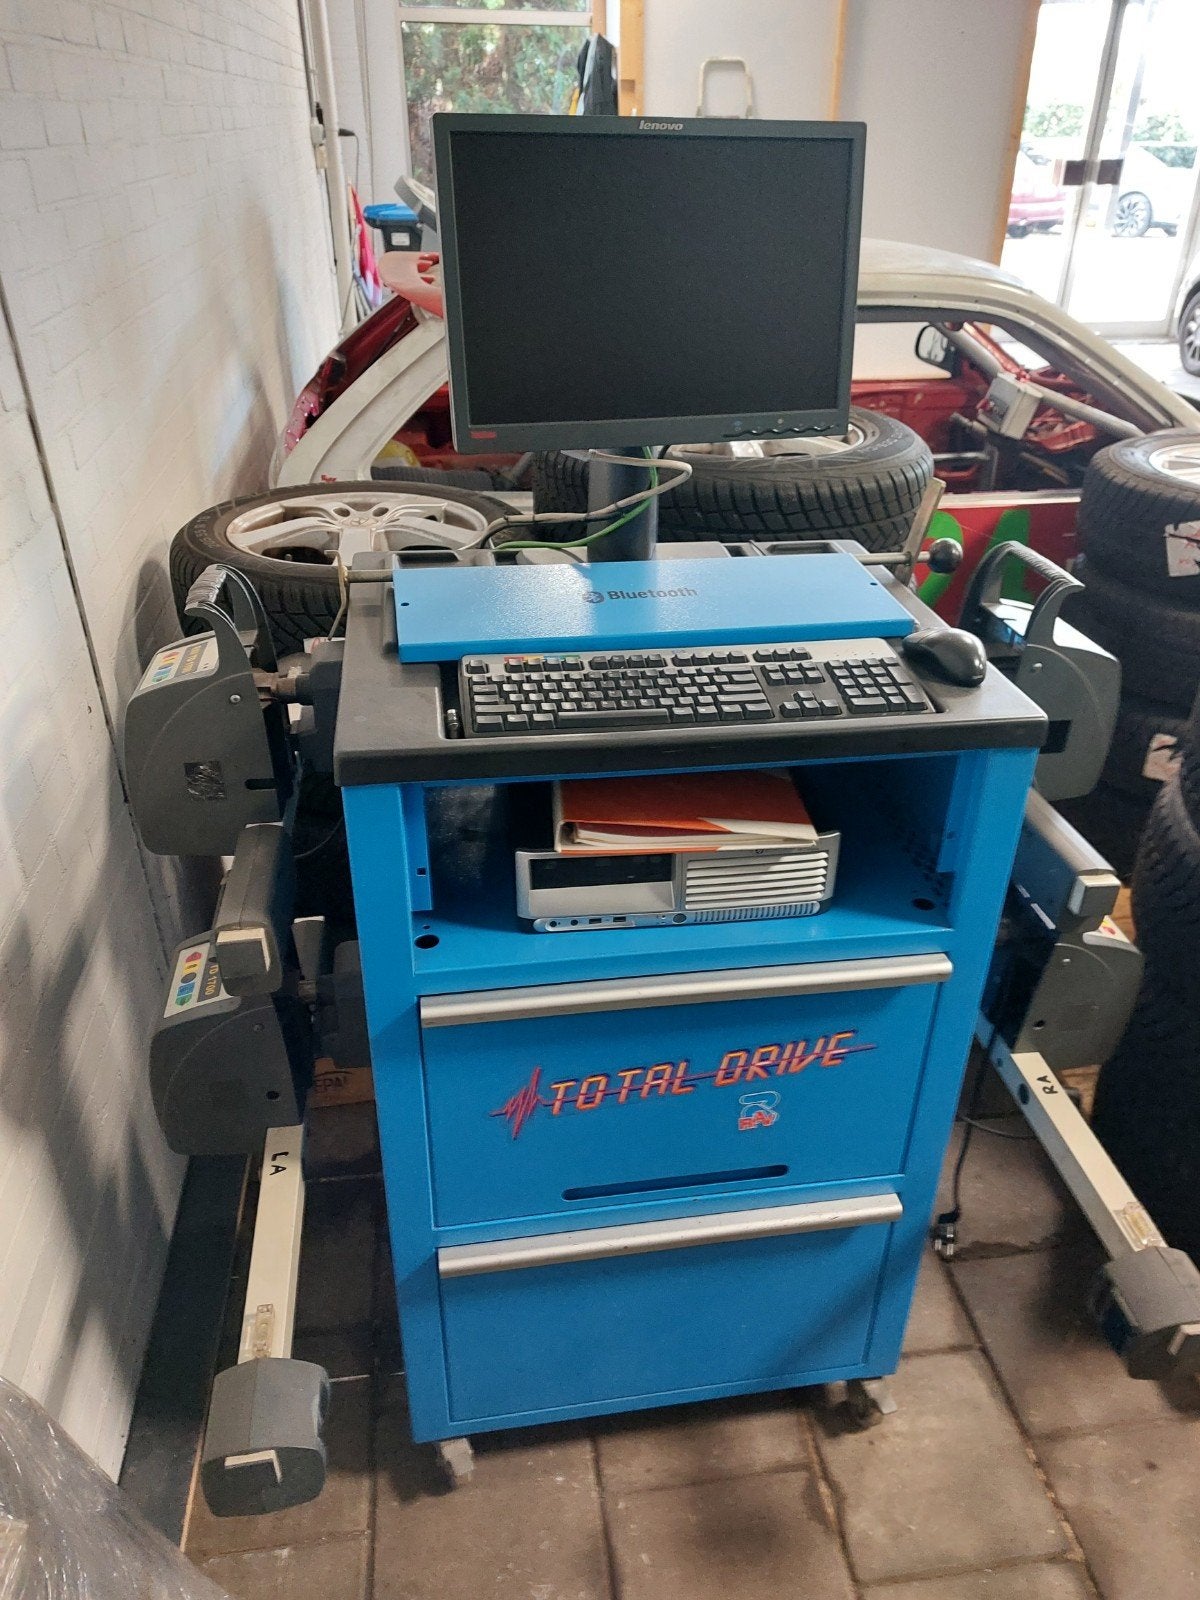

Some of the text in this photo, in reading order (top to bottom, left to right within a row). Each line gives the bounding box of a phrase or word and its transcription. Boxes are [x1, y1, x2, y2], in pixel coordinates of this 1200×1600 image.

[639, 119, 684, 131] lenovo
[606, 587, 698, 601] Bluetooth
[550, 1029, 858, 1116] TOTAL DRIVE
[1036, 1075, 1059, 1095] RA
[738, 1110, 776, 1130] RAV
[269, 1151, 290, 1176] LA
